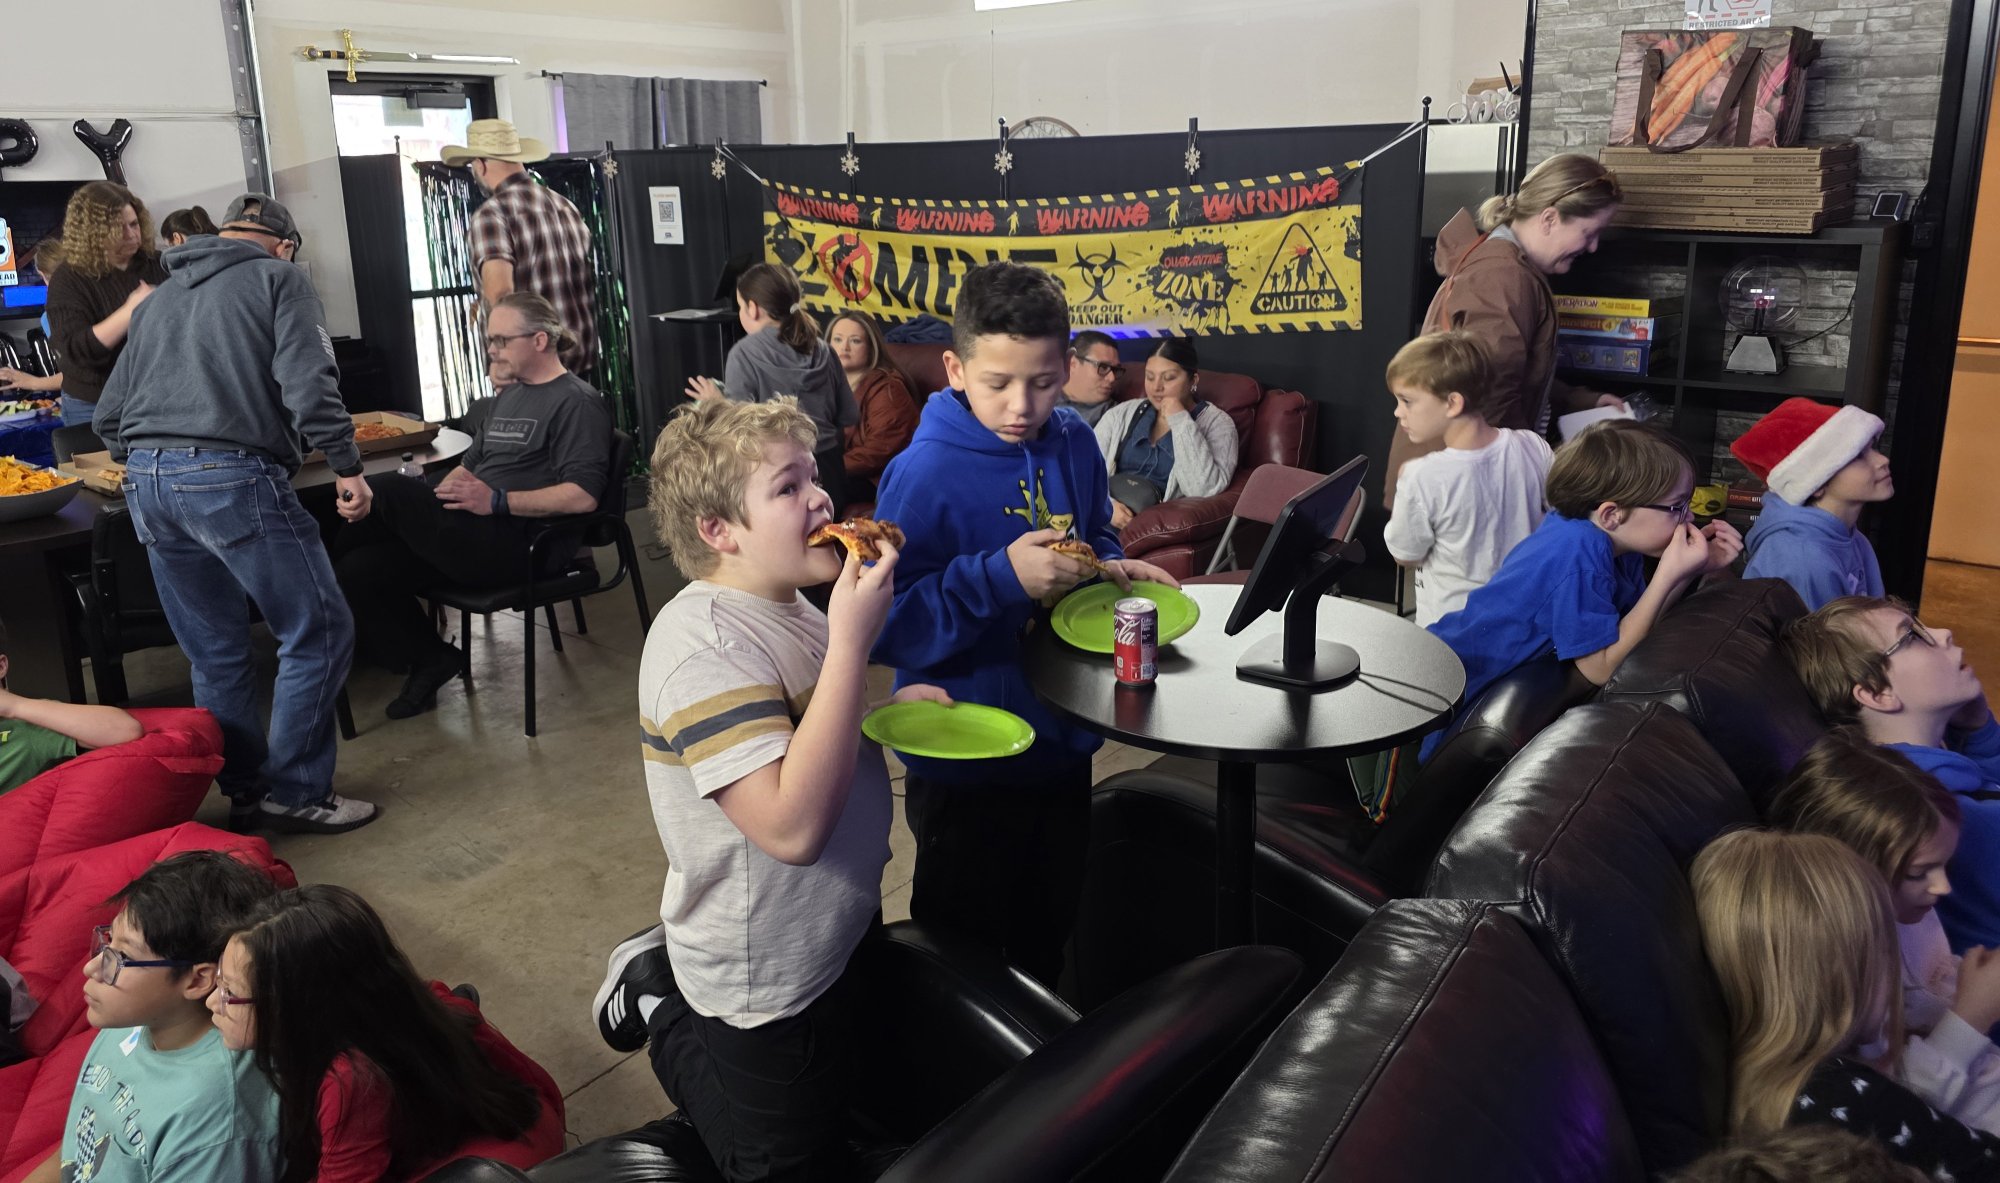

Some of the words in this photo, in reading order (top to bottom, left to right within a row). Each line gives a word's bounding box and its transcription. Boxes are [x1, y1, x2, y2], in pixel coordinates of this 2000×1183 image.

[1688, 20, 1738, 28] RESTRICTED
[777, 191, 859, 225] WARNING
[1202, 176, 1340, 222] WARNING
[896, 206, 996, 233] WARNING
[1036, 201, 1150, 235] WARNING
[1164, 252, 1223, 268] QUARANTINE
[1156, 269, 1224, 301] ZONE
[1069, 304, 1098, 313] KEEP
[1100, 304, 1125, 313] OUT
[1256, 293, 1337, 313] CAUTION
